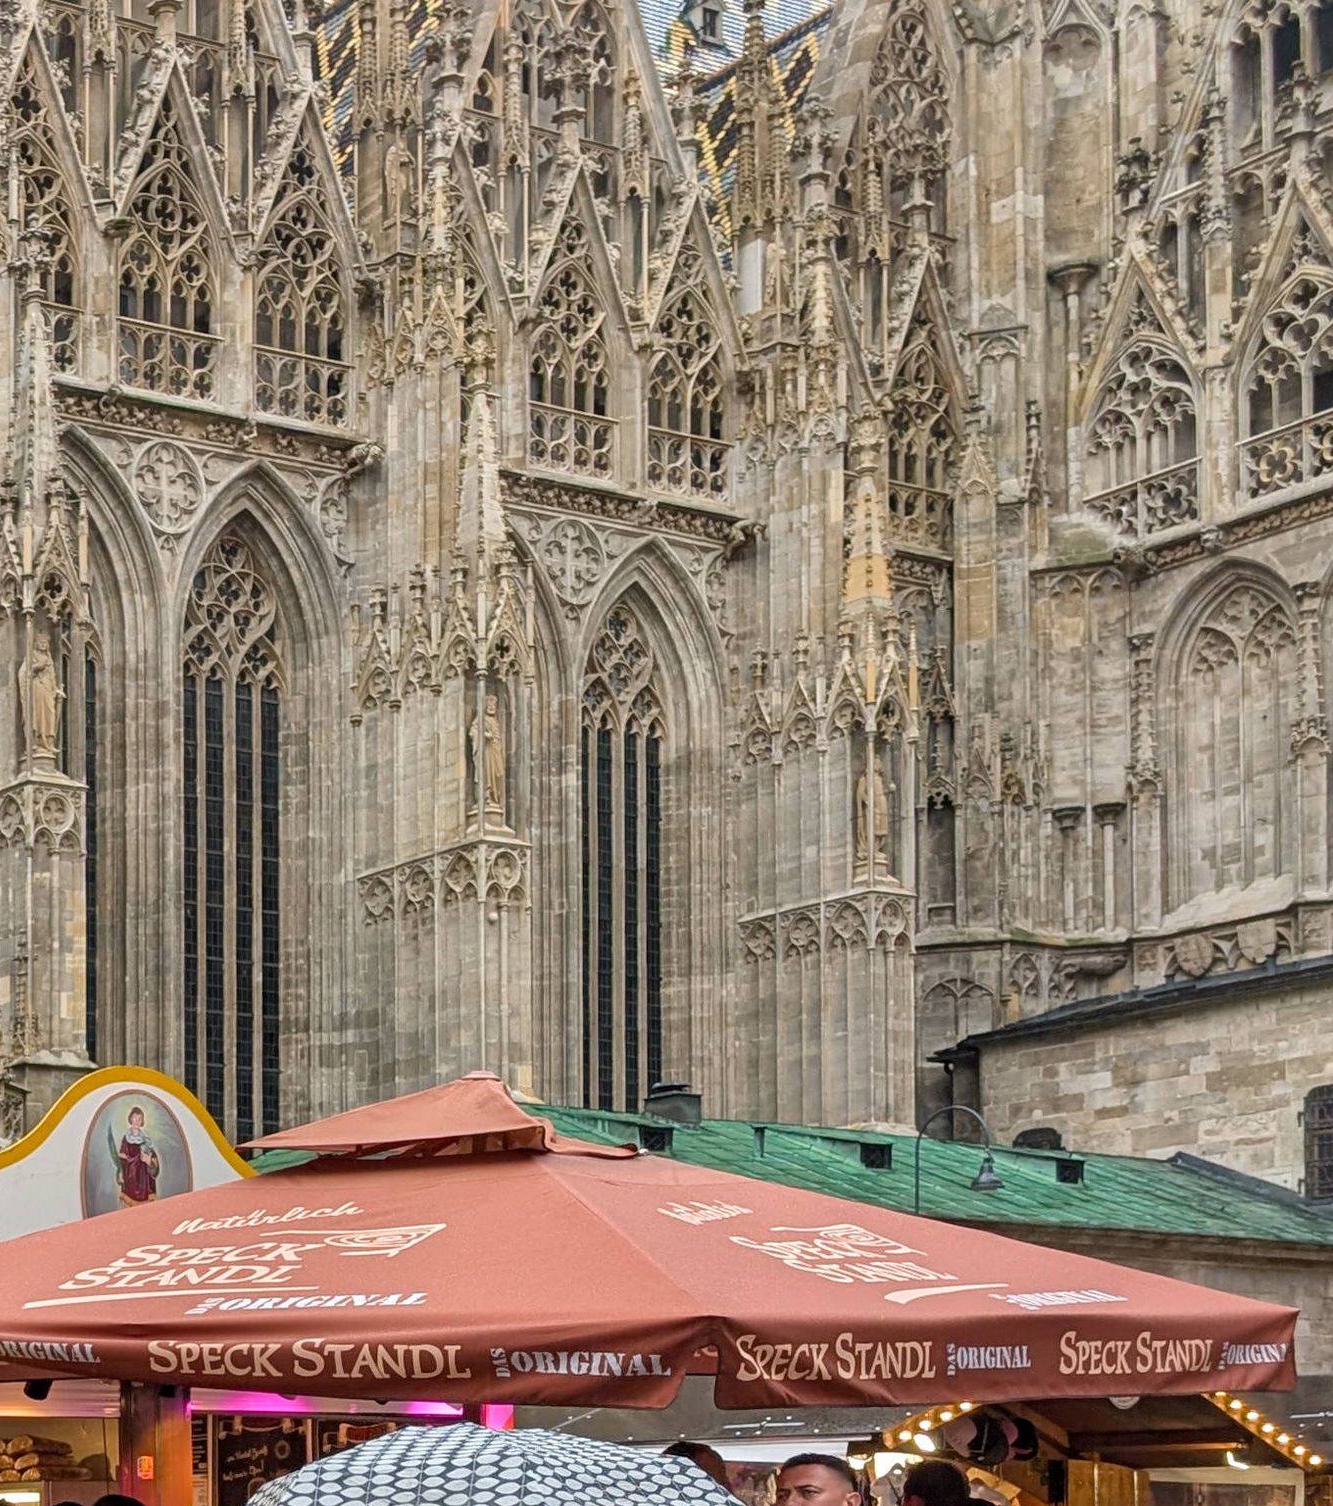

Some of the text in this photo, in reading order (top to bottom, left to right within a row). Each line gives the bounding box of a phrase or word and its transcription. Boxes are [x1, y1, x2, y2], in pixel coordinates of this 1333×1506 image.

[172, 1202, 364, 1235] Natürlich
[109, 1243, 327, 1269] SPECK
[58, 1265, 303, 1289] STANDL
[218, 1292, 429, 1311] ORIGINAL
[147, 1340, 283, 1377] SPECK
[292, 1338, 472, 1379] STANDL
[490, 1347, 512, 1378] DAS
[511, 1351, 672, 1377] ORIGINAL
[735, 1334, 832, 1382] SPECK
[835, 1332, 937, 1380] STANDL
[946, 1343, 957, 1376] DAS
[957, 1345, 1032, 1370] ORIGINAL
[1059, 1331, 1132, 1375] SPECK
[1136, 1331, 1213, 1374] STANDL
